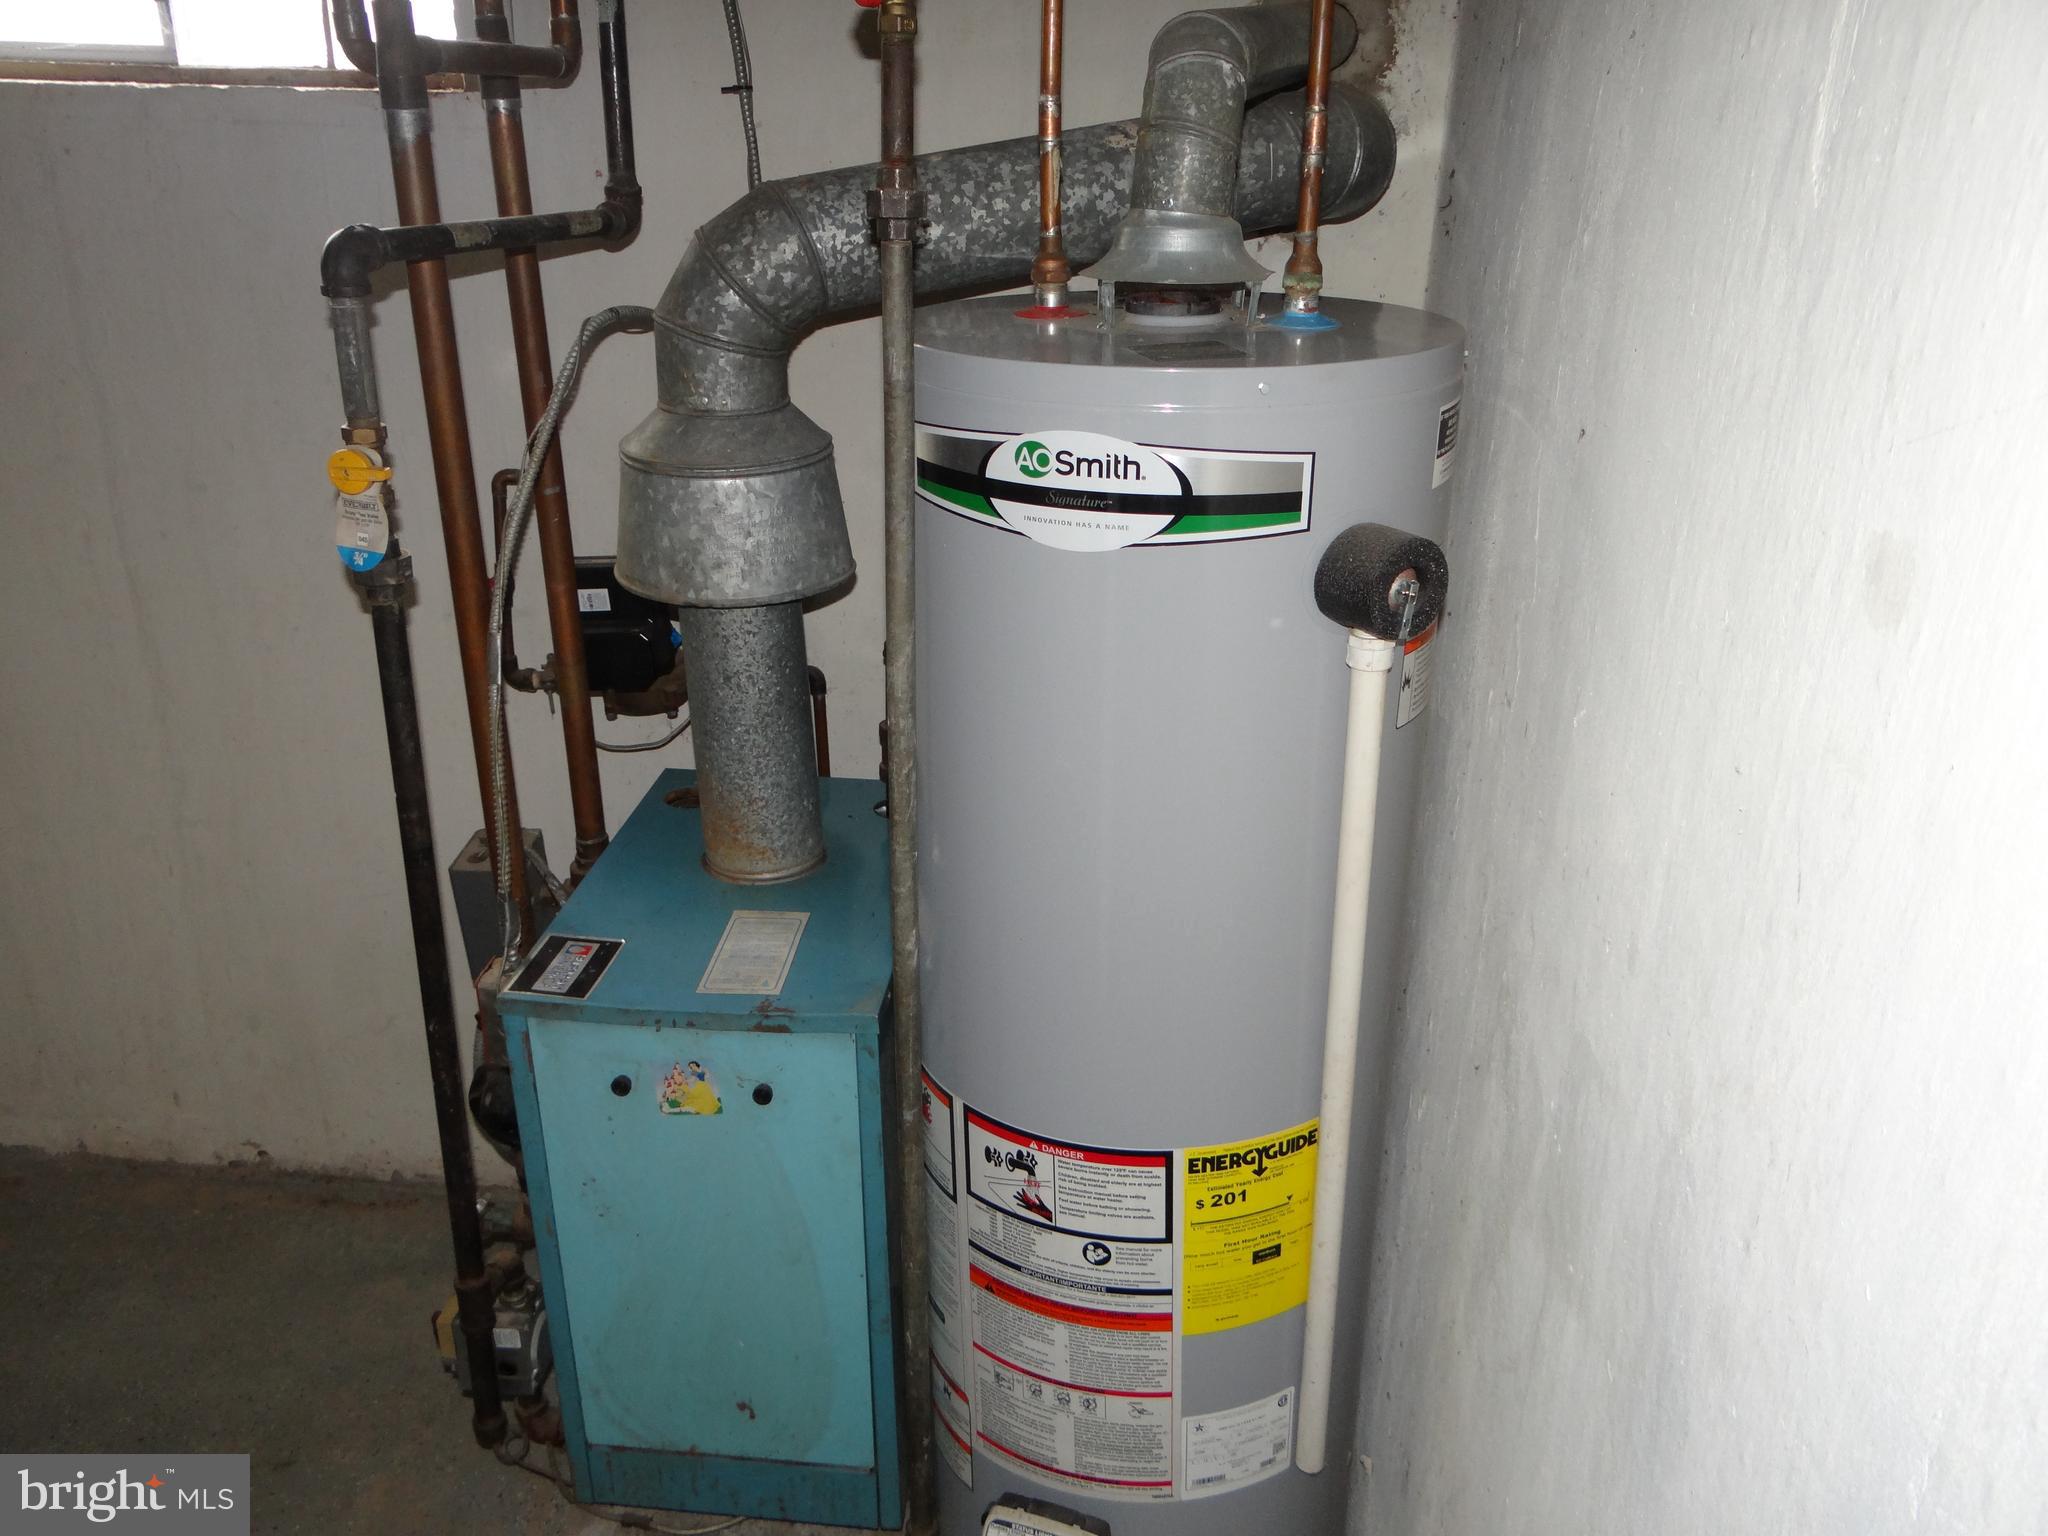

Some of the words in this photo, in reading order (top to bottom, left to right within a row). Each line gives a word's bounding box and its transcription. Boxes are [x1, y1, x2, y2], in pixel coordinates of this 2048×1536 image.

[1045, 490, 1108, 509] Signature
[1023, 515, 1073, 527] INNOVATION
[1075, 521, 1092, 529] HAS
[1104, 523, 1130, 531] NAME
[1042, 1144, 1084, 1160] DANGER
[1211, 1189, 1247, 1207] 201
